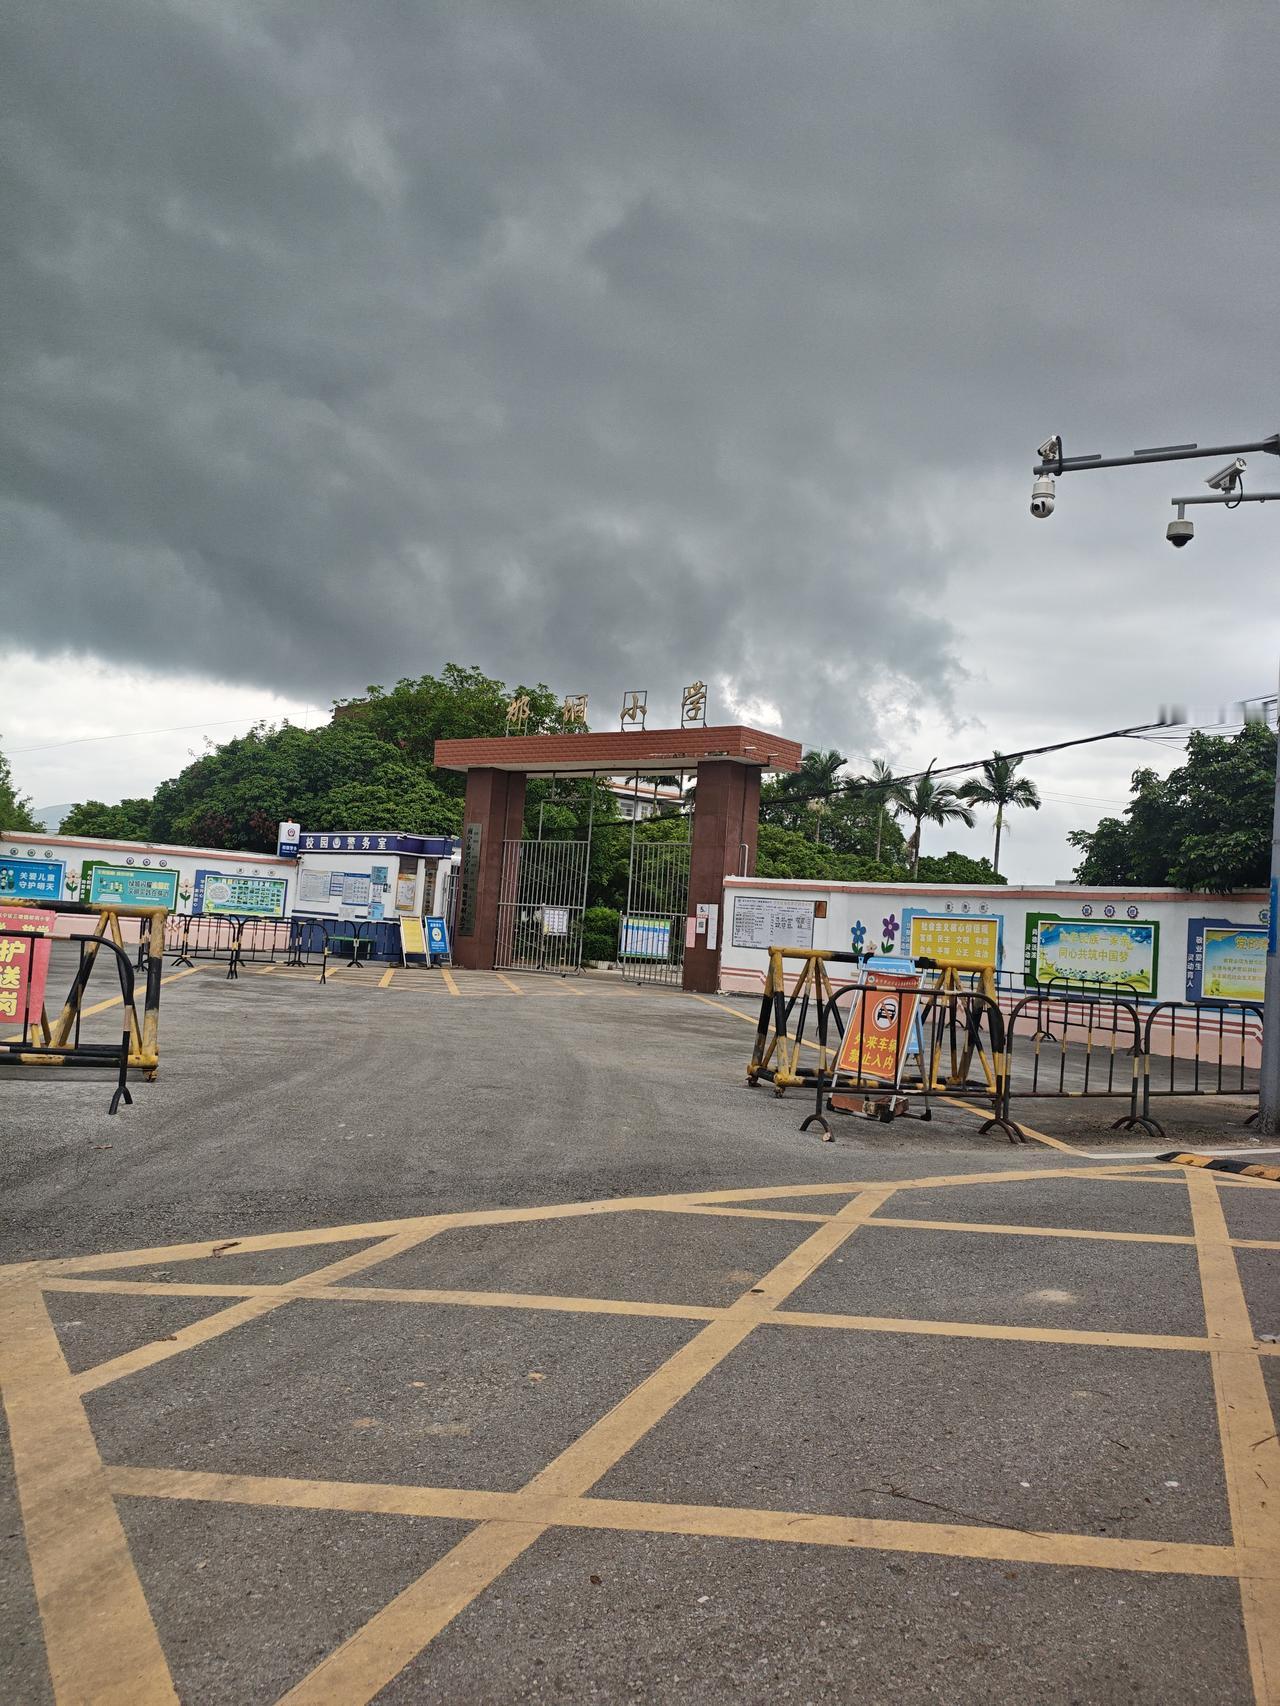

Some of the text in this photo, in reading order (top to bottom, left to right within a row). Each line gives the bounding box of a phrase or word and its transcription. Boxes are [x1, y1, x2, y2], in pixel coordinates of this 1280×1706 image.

[306, 836, 387, 850] 校园警务室
[20, 872, 55, 882] 关爱儿童
[19, 881, 55, 891] 守护明天
[921, 921, 989, 934] 社会主义核心价值观
[937, 935, 951, 943] 民主
[956, 936, 970, 944] 文明
[1059, 932, 1133, 948] 中华民族一家亲
[1058, 946, 1130, 962] 同心共筑中国梦
